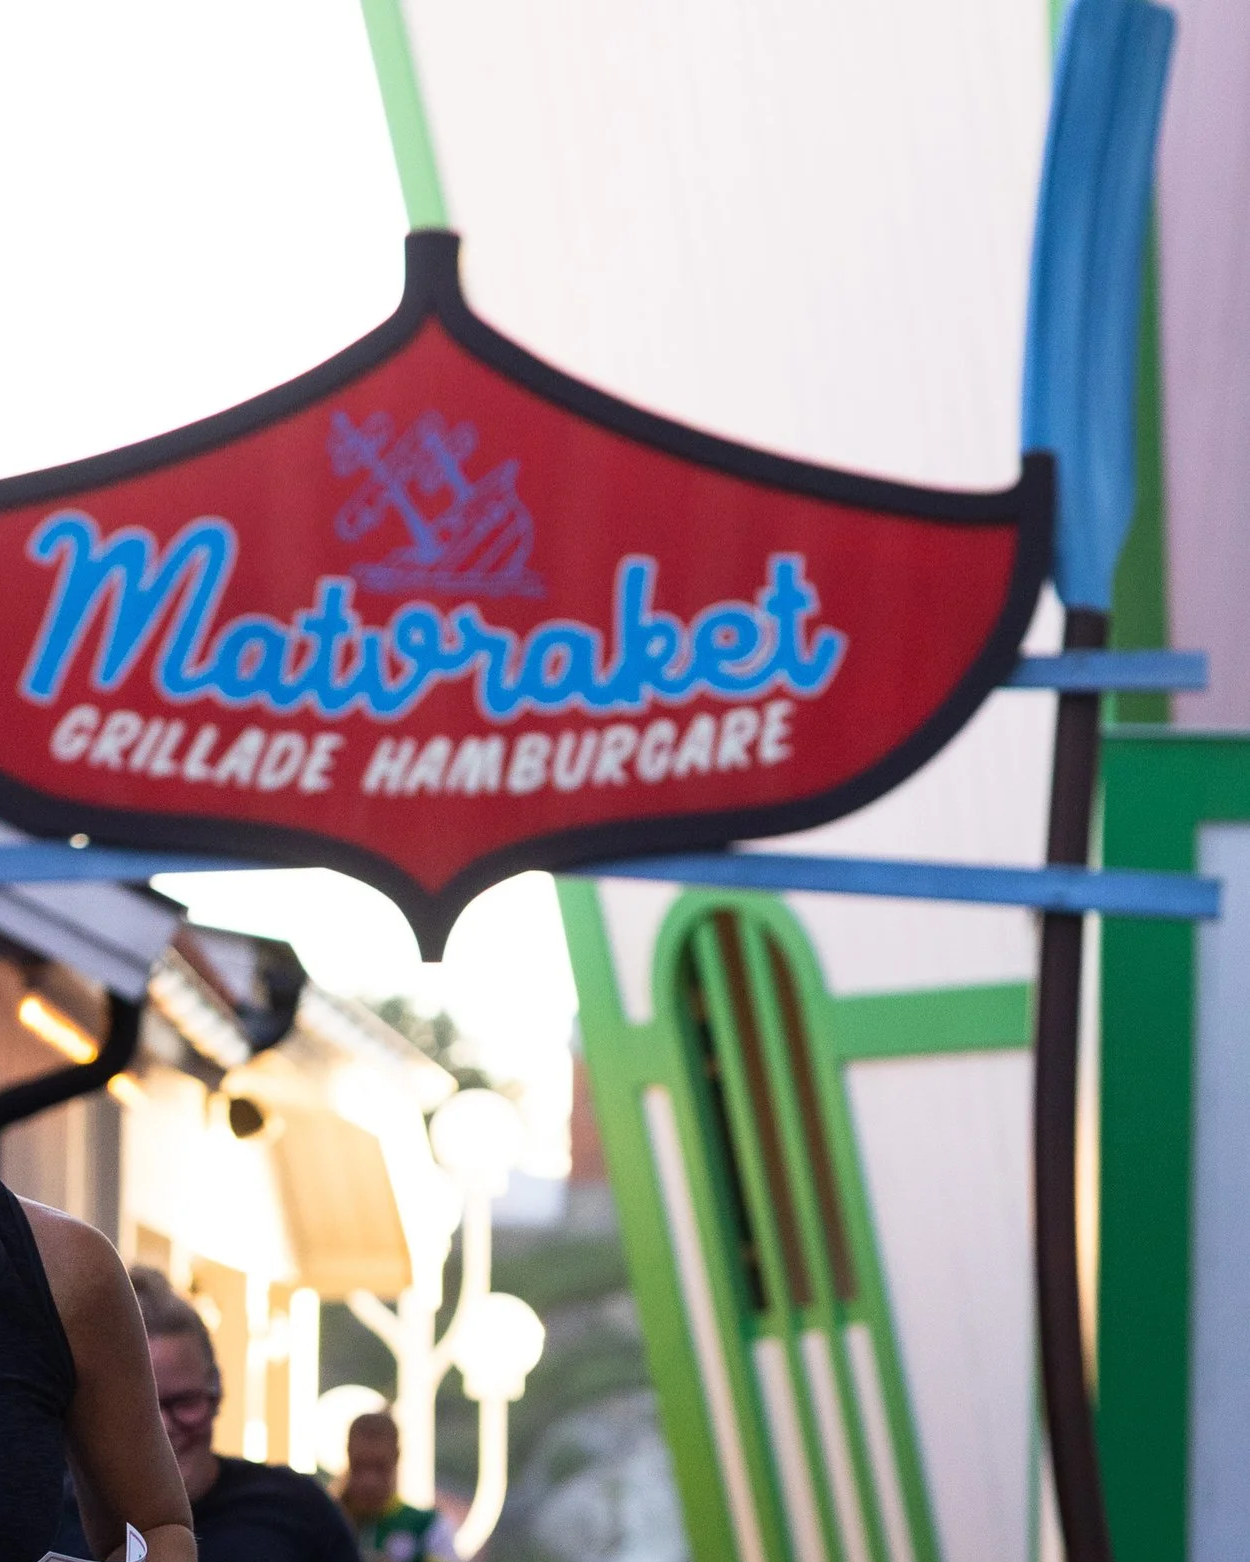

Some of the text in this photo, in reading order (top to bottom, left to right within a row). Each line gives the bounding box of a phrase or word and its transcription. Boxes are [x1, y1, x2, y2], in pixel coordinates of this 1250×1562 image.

[19, 511, 847, 723] Matvraket
[51, 701, 796, 794] GRILLADE HAMBURGARE
